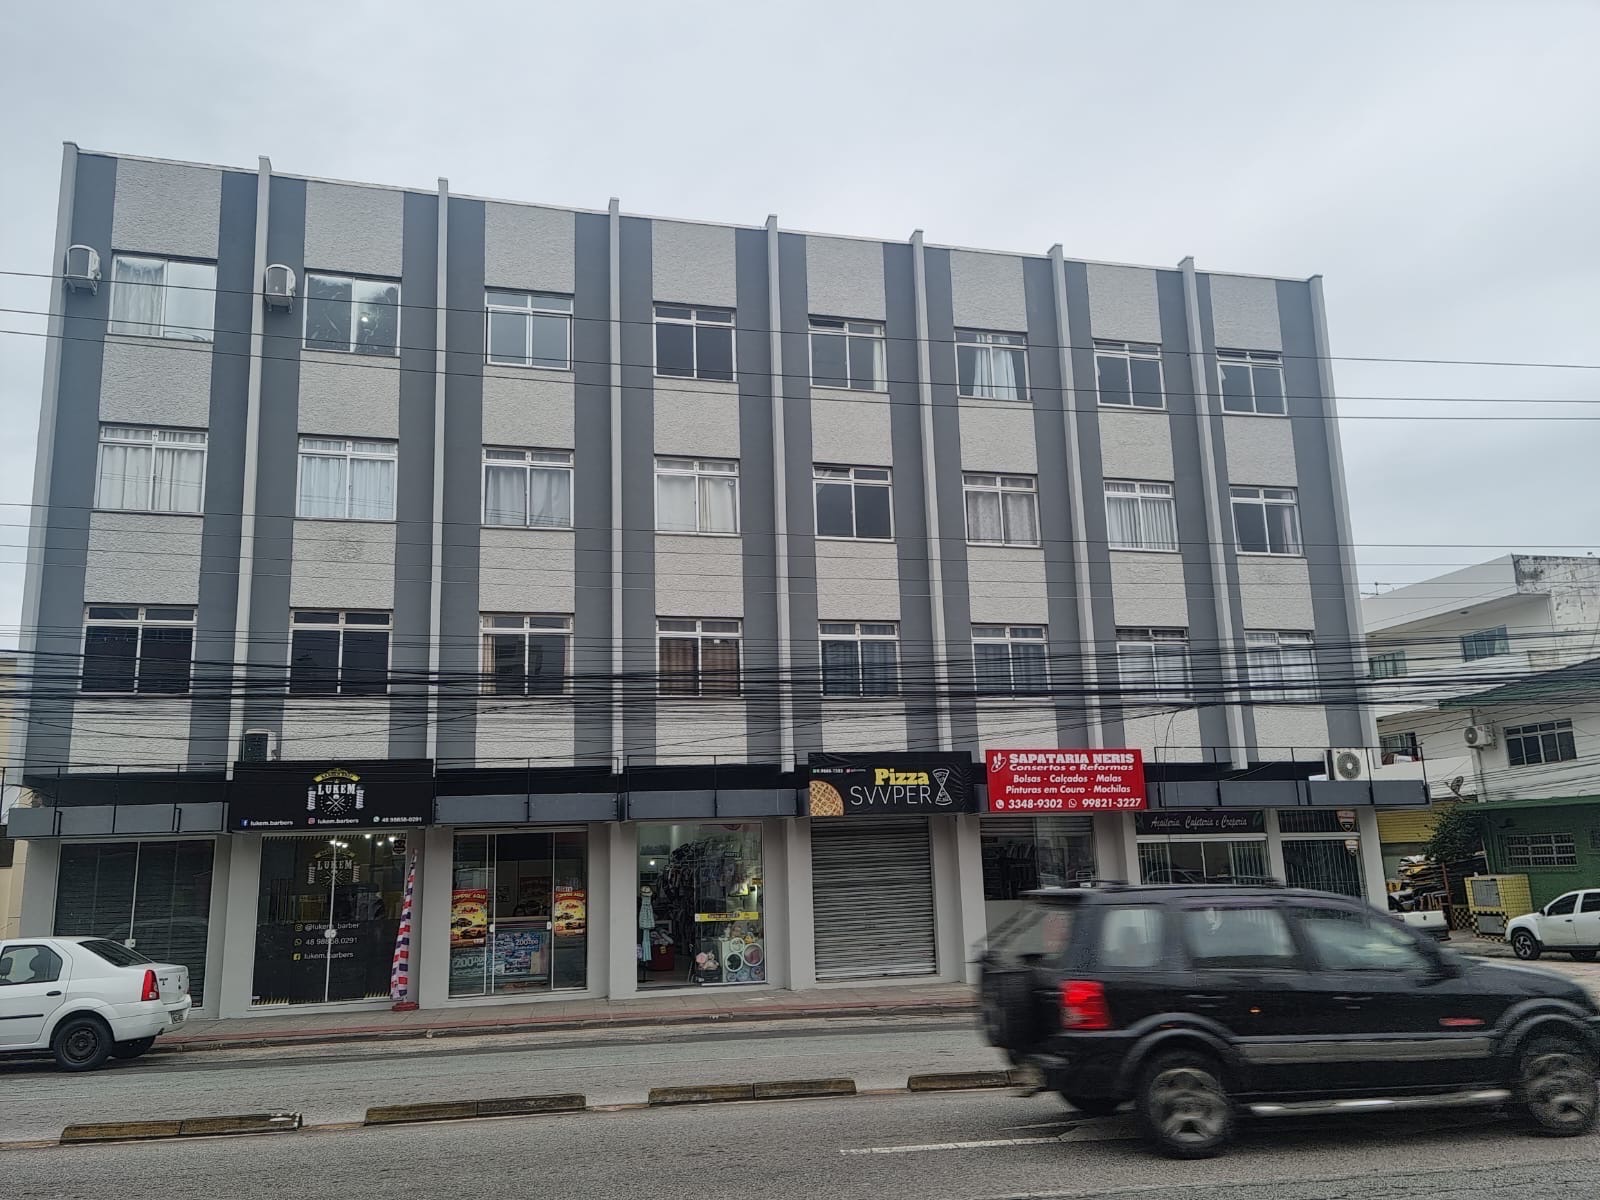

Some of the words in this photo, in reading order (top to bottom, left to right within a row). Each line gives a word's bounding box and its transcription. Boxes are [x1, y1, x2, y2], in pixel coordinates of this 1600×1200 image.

[1009, 753, 1089, 764] SAPATARIA
[1092, 753, 1135, 764] NERIS
[1080, 763, 1133, 771] Reformas
[874, 768, 929, 786] Pizza
[1013, 774, 1041, 783] Bolsas
[1049, 774, 1088, 785] Calçados
[1096, 774, 1122, 782] Malas
[317, 783, 356, 795] LUKEM
[1006, 785, 1041, 794] Pinturas
[1060, 785, 1085, 794] Couro
[1093, 784, 1131, 793] Mochilas
[1008, 799, 1062, 808] 3348-9302
[1082, 798, 1142, 808] 99821-3227
[317, 859, 352, 871] LUKEM
